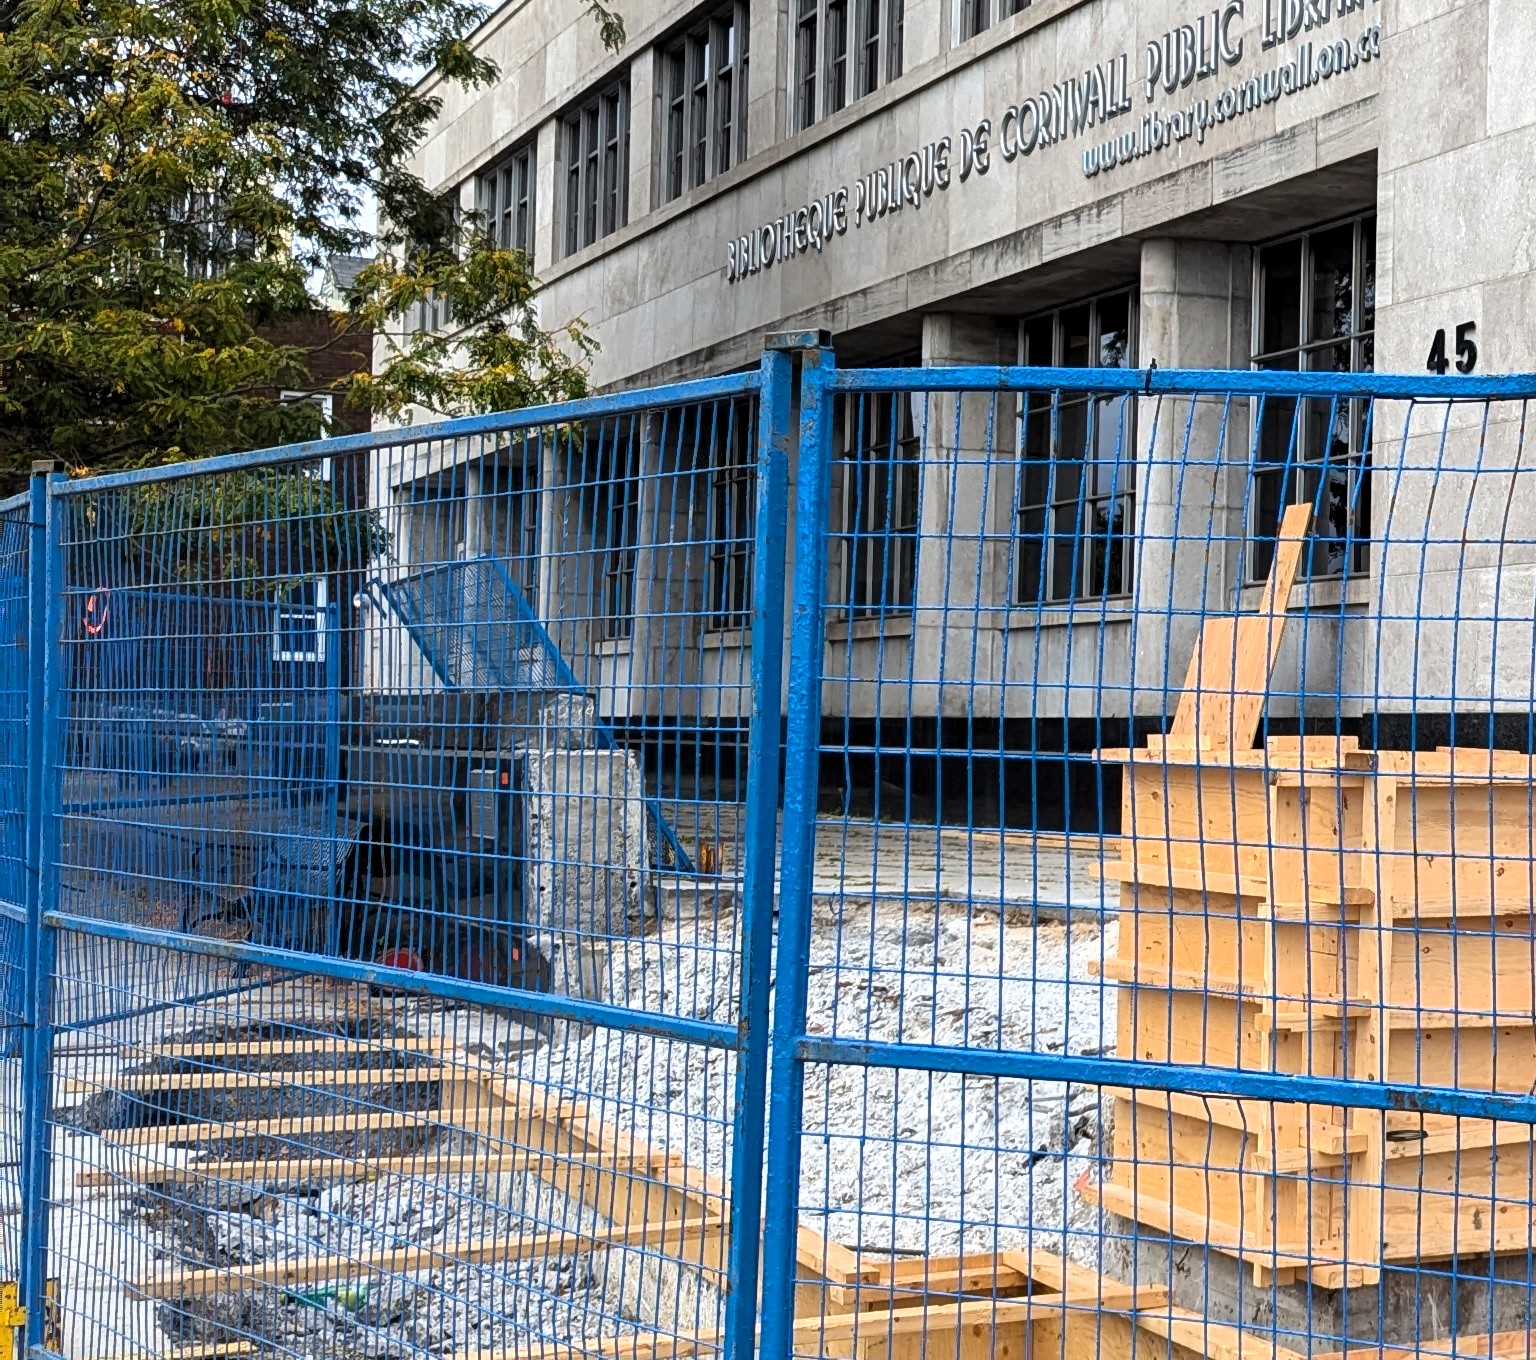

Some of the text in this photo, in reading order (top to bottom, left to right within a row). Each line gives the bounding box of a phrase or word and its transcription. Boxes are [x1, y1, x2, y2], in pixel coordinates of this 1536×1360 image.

[727, 185, 849, 283] BIBLIOTHEQUE
[855, 136, 952, 228] PUBLIQUE
[959, 118, 991, 183] DE
[1000, 53, 1132, 163] CORNWALL
[1427, 321, 1477, 375] 45
